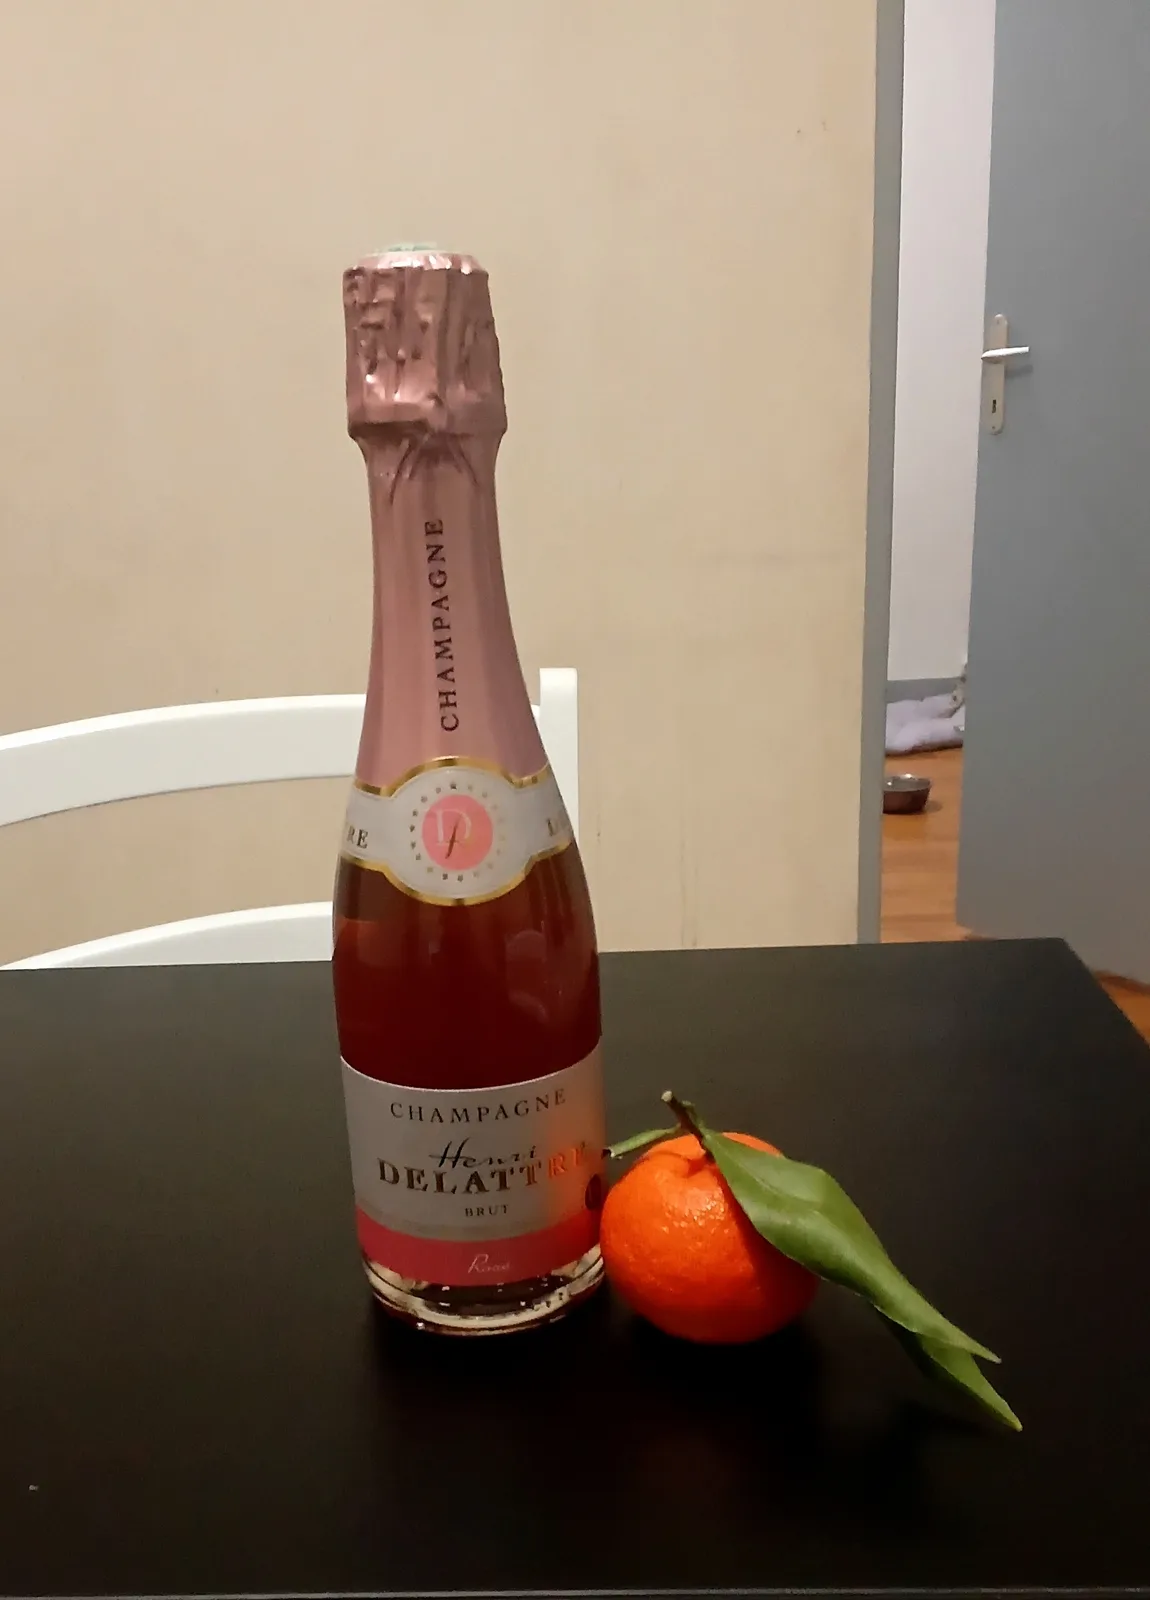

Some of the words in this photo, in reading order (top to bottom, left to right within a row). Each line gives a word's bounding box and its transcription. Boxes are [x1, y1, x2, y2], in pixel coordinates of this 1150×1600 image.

[425, 518, 459, 732] CHAMPAGNE
[390, 1088, 566, 1124] CHAMPAGNE
[428, 1137, 537, 1169] Henri
[464, 1204, 509, 1217] BRUT
